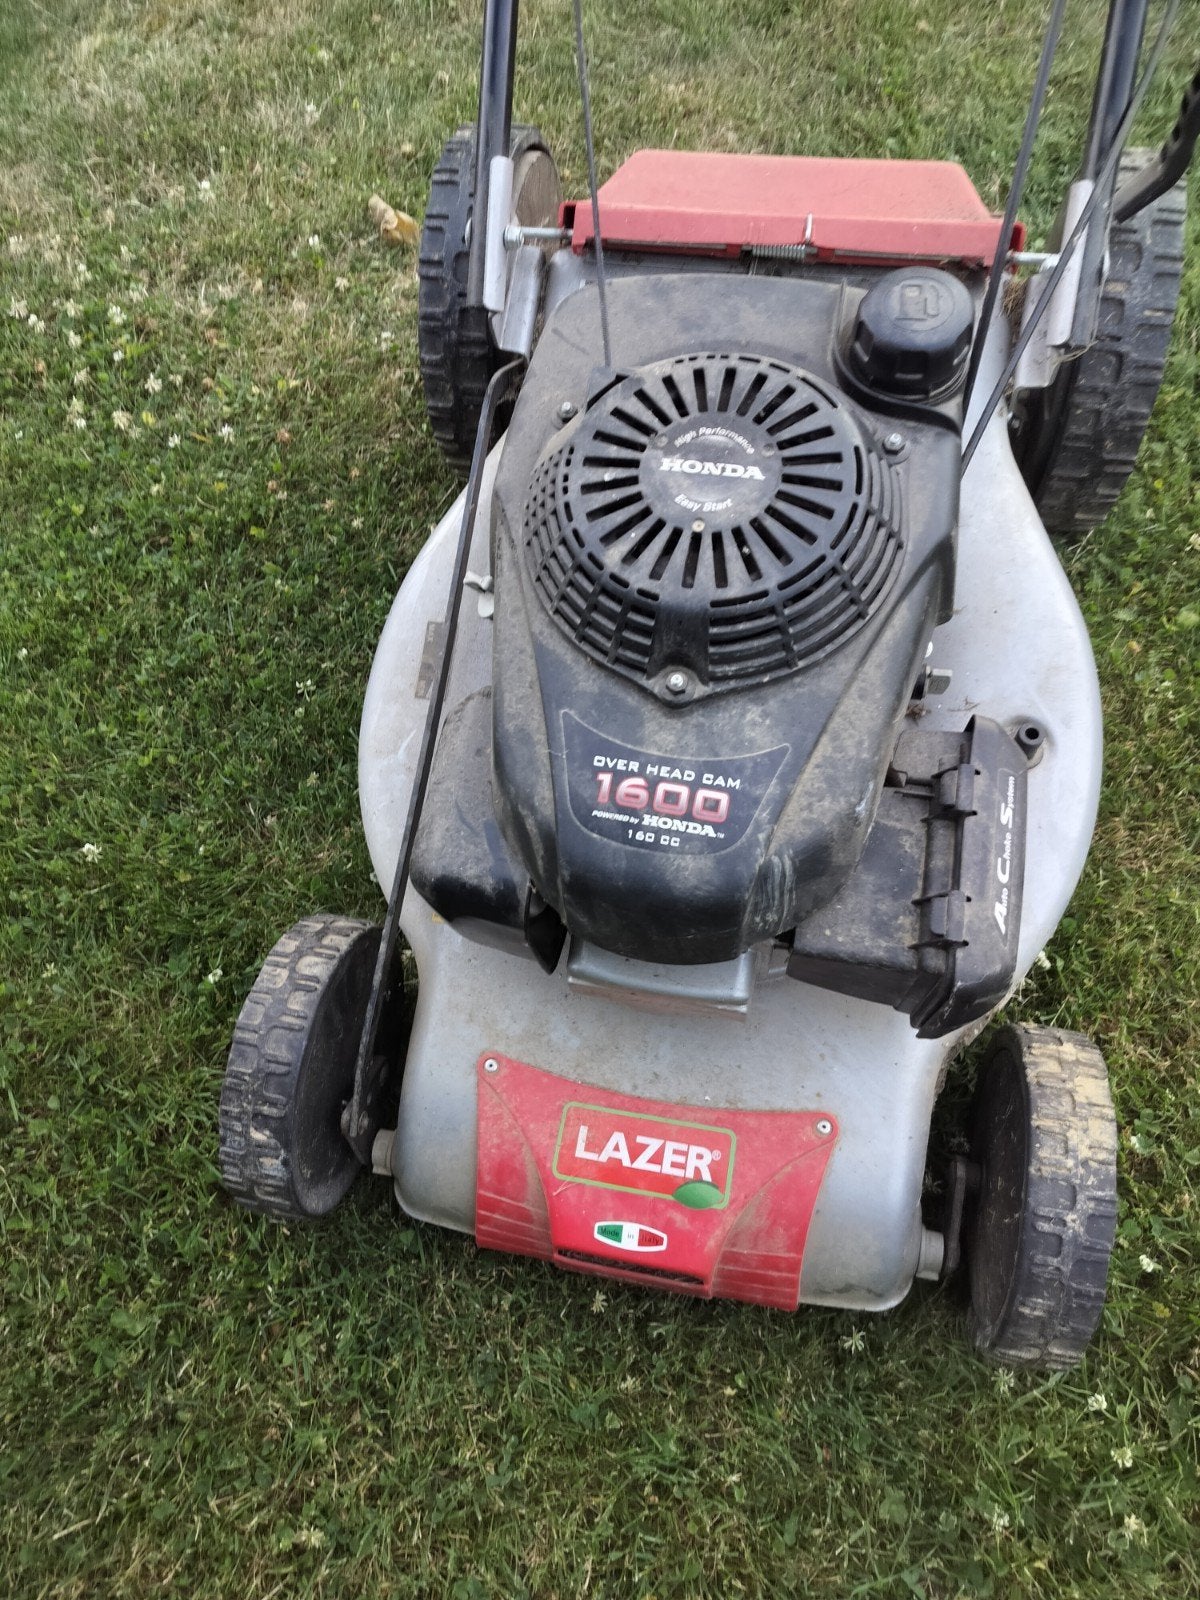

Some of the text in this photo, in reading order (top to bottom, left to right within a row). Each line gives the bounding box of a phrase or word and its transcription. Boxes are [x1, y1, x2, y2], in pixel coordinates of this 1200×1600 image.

[674, 426, 755, 455] High Performance
[659, 457, 766, 481] HONDA
[674, 493, 734, 512] Easy Start
[593, 755, 742, 790] OVER HEAD CAM
[595, 771, 731, 824] 1600
[591, 809, 630, 823] POWERED
[629, 815, 640, 825] by
[627, 829, 681, 847] 160 CC
[600, 1226, 620, 1238] Made
[641, 1232, 660, 1246] Italy
